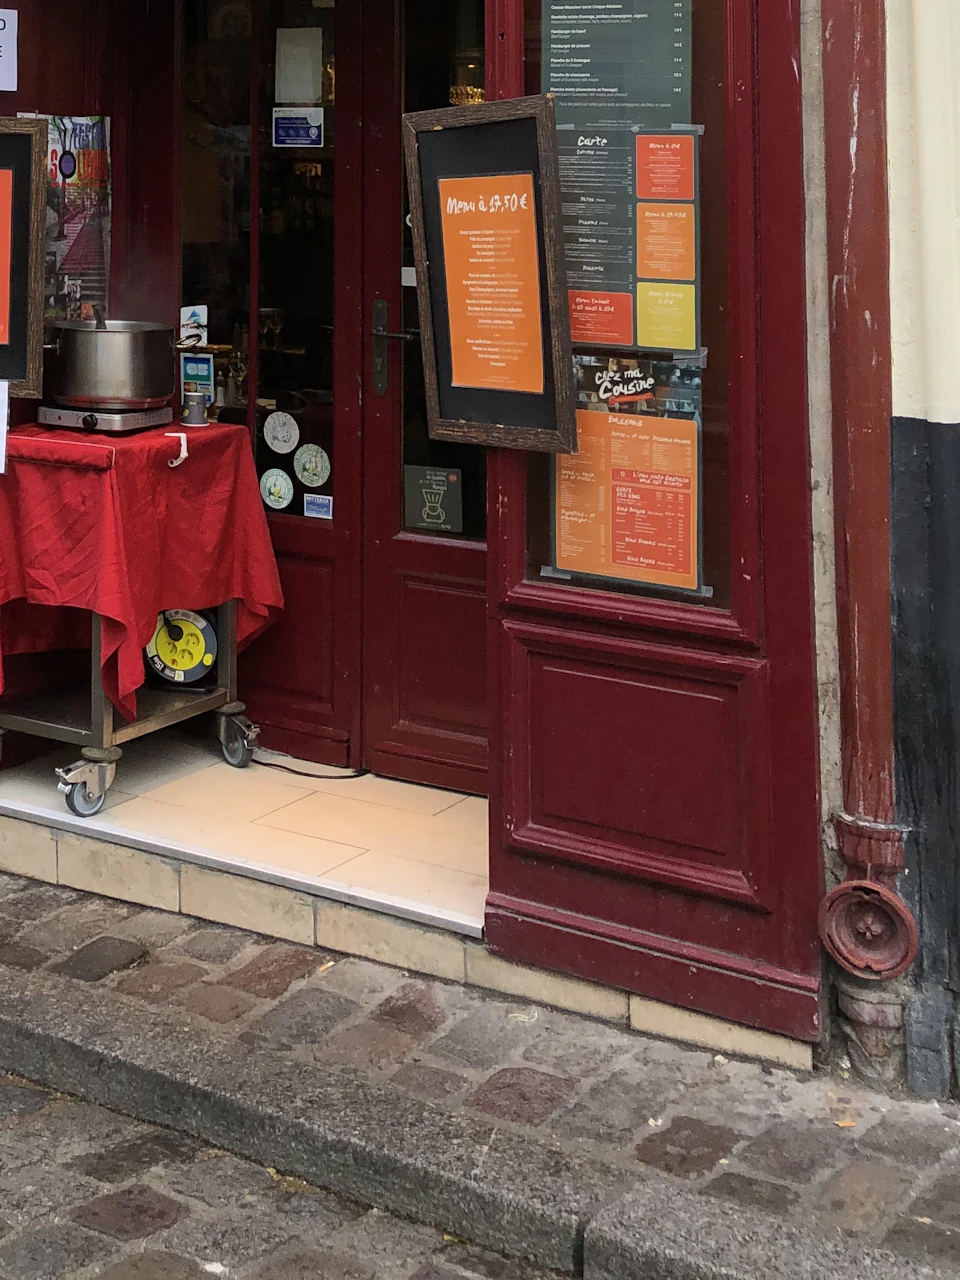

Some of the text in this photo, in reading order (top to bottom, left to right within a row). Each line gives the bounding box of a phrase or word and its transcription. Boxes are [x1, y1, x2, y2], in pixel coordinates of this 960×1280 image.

[578, 136, 608, 147] Carte
[447, 197, 475, 215] Menu
[478, 195, 488, 212] à
[595, 368, 644, 384] Chez ma
[598, 377, 655, 400] Cousine
